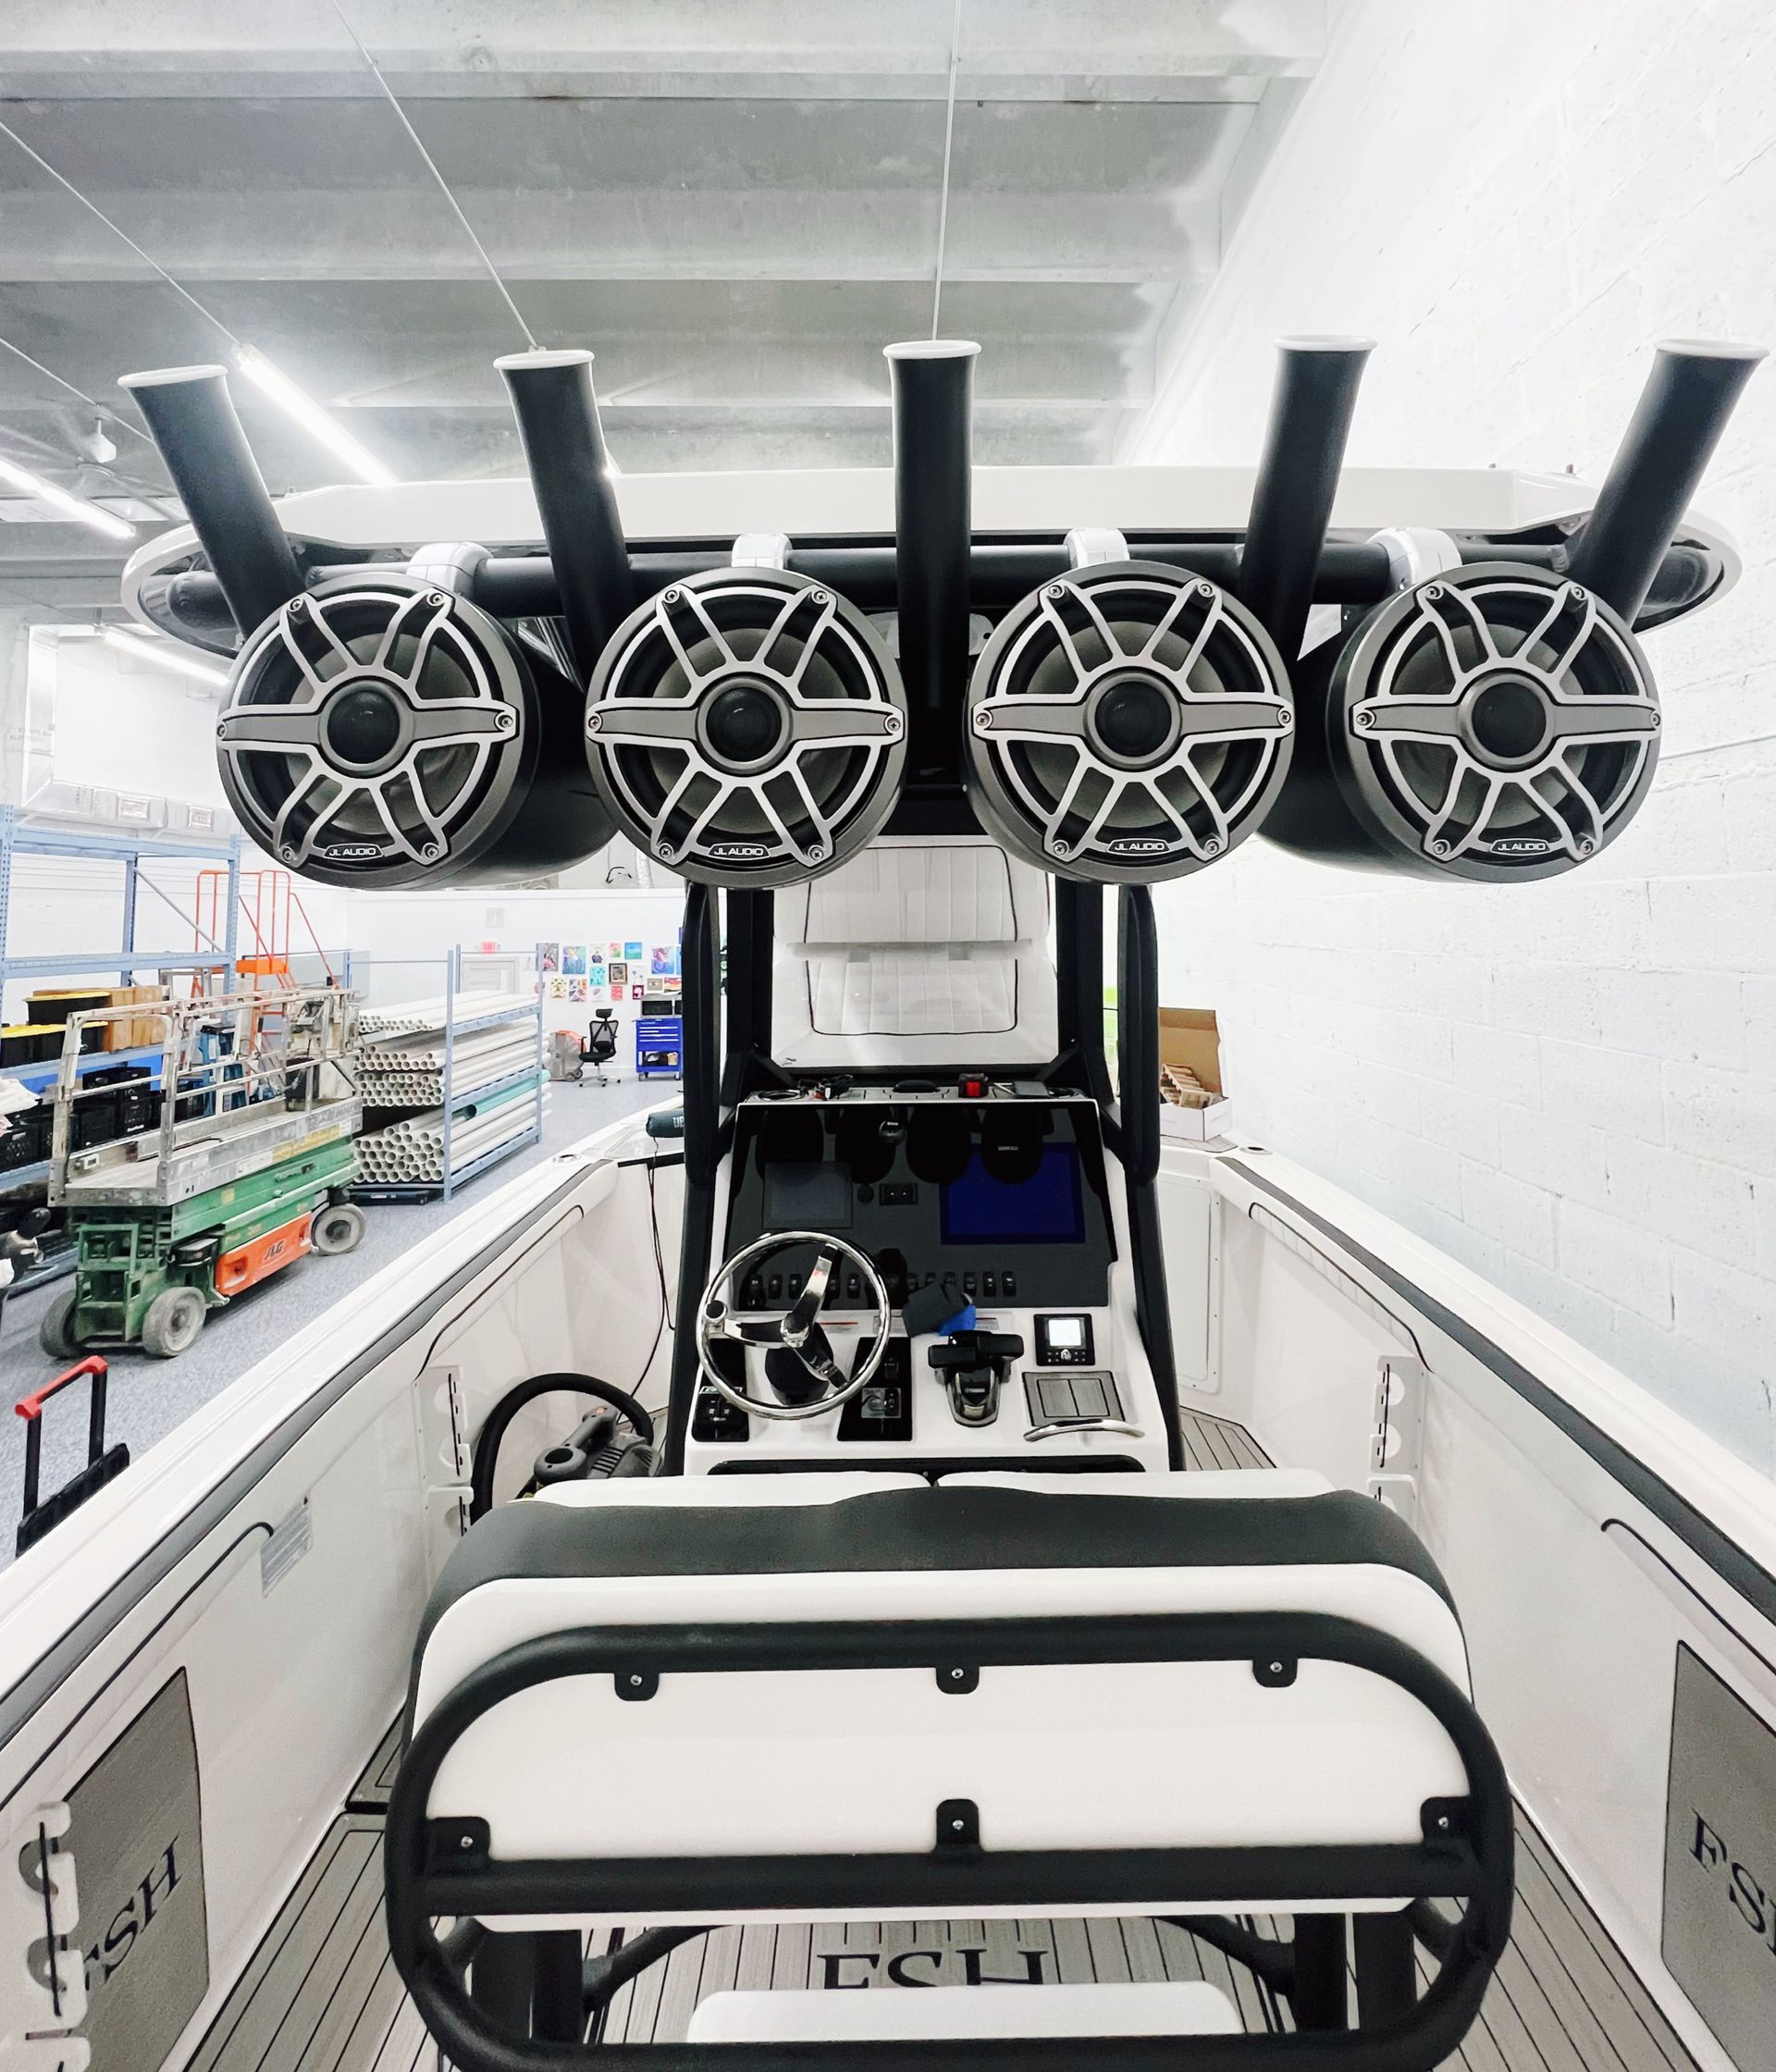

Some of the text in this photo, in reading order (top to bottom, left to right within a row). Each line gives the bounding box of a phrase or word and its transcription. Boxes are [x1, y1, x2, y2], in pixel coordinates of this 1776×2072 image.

[342, 847, 376, 856] AUDIO
[713, 847, 763, 856] JL AUDIO
[1497, 843, 1546, 851] JL AUDIO
